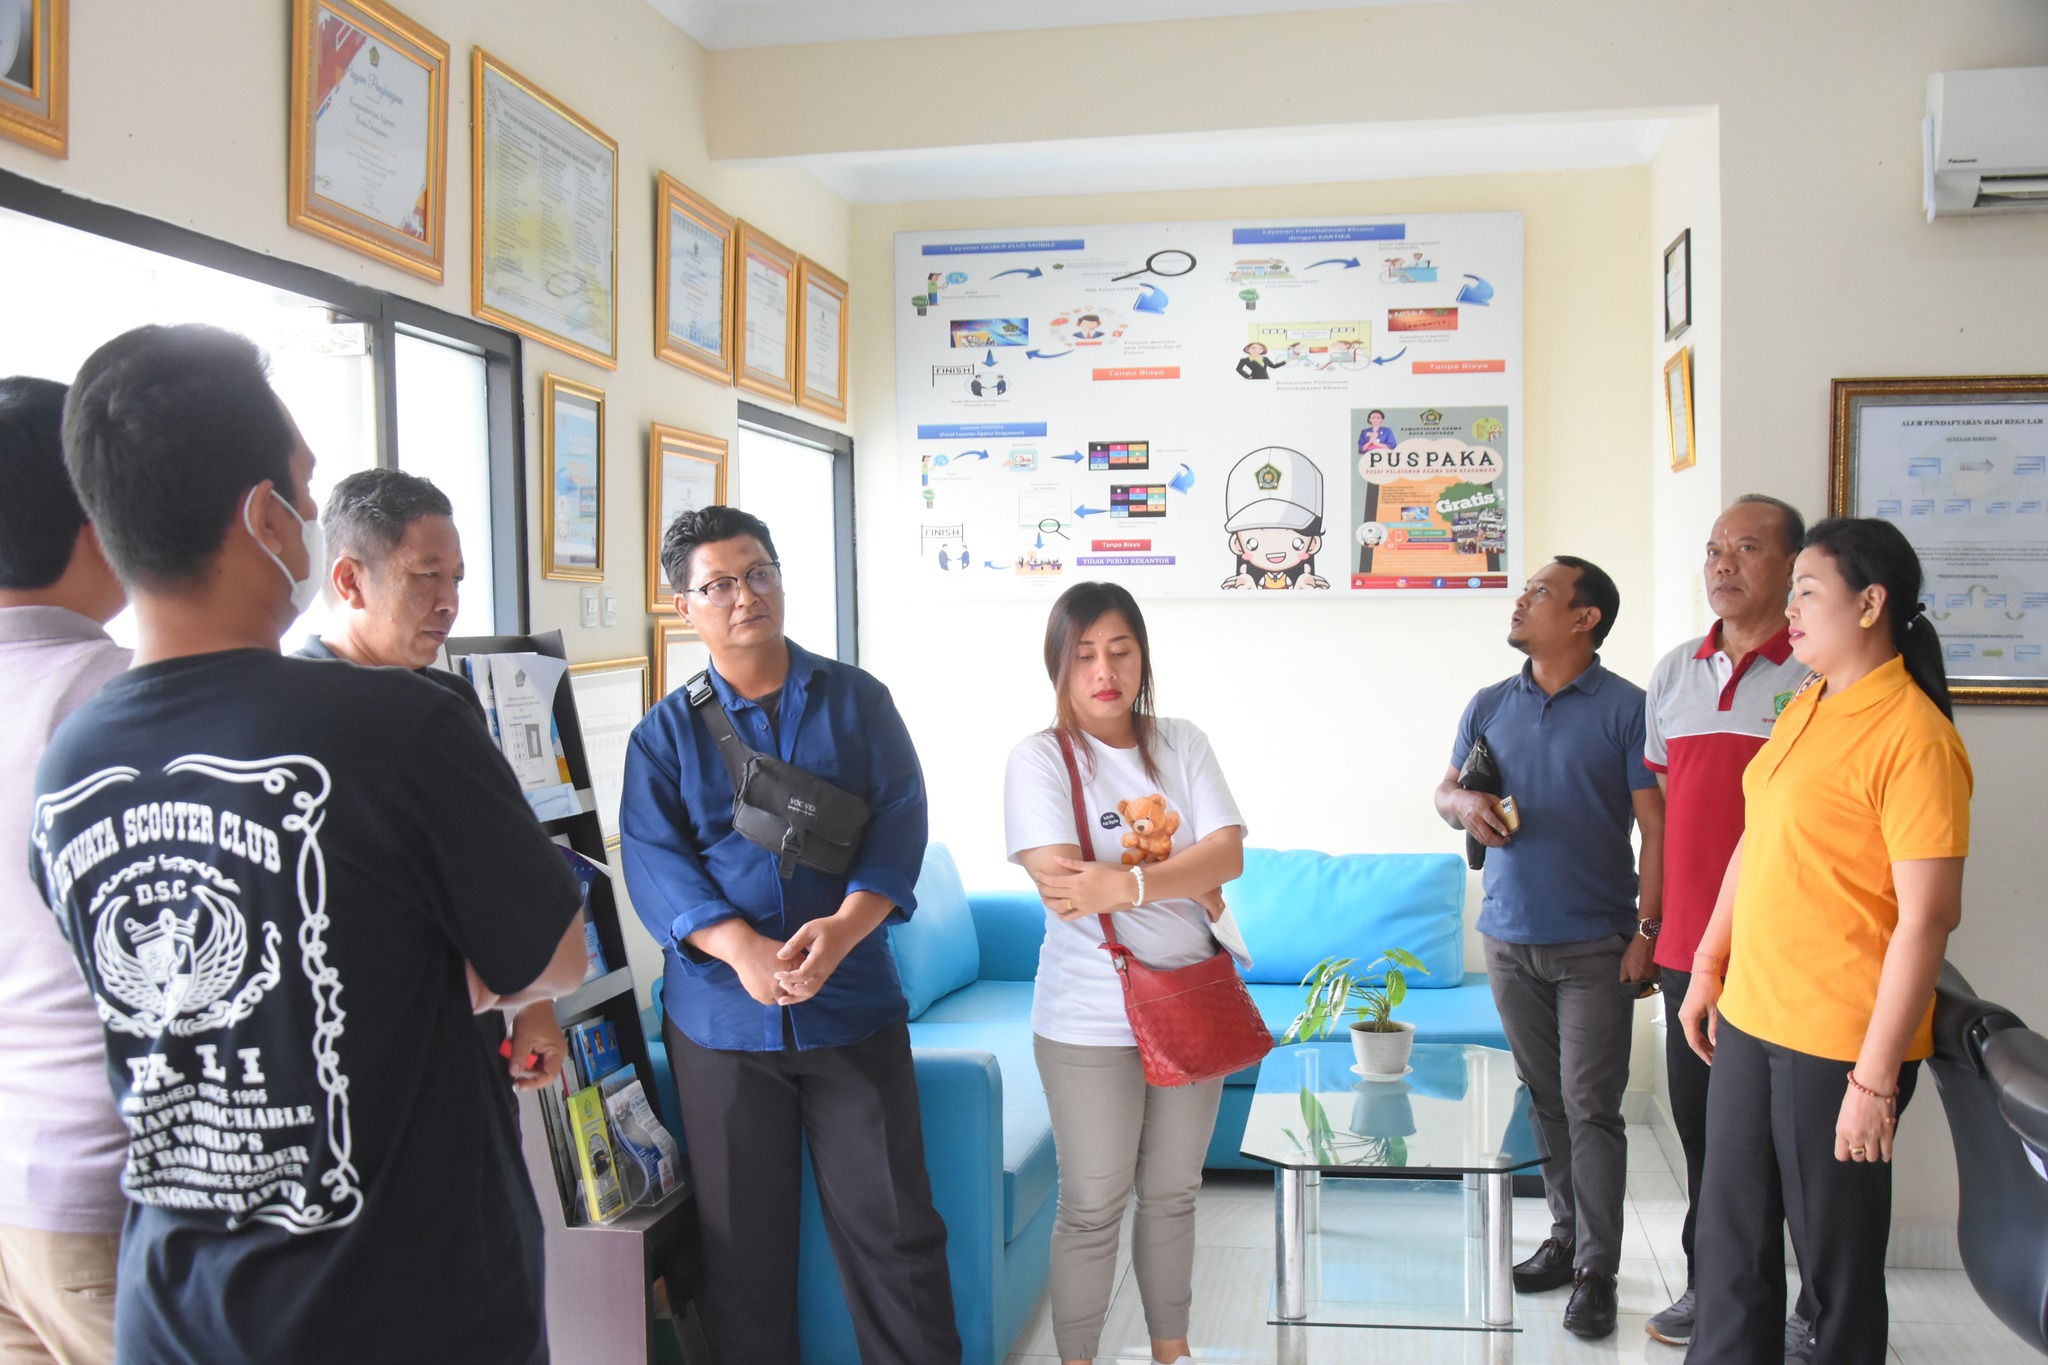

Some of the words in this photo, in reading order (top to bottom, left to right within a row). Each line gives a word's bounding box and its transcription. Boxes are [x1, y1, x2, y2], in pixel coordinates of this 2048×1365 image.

[950, 244, 980, 252] Layanan
[1429, 363, 1460, 371] Tanpa
[1462, 362, 1488, 371] Biaya
[1108, 370, 1138, 379] Tanpa
[1139, 369, 1165, 378] Biaya
[1924, 419, 1983, 427] PENDAFTARAN
[1984, 418, 2003, 426] HAJI
[2004, 418, 2044, 426] REGULAR
[1370, 451, 1494, 467] PUSPAKA
[1436, 492, 1496, 514] Gratis
[1102, 541, 1122, 549] Tanpa
[1123, 541, 1141, 549] Biaya
[1106, 557, 1130, 565] PERLU
[123, 801, 214, 848] SCOOTER
[219, 811, 281, 873] CLUB
[209, 1145, 310, 1173] HOLDER
[234, 1163, 304, 1190] SCOOTER
